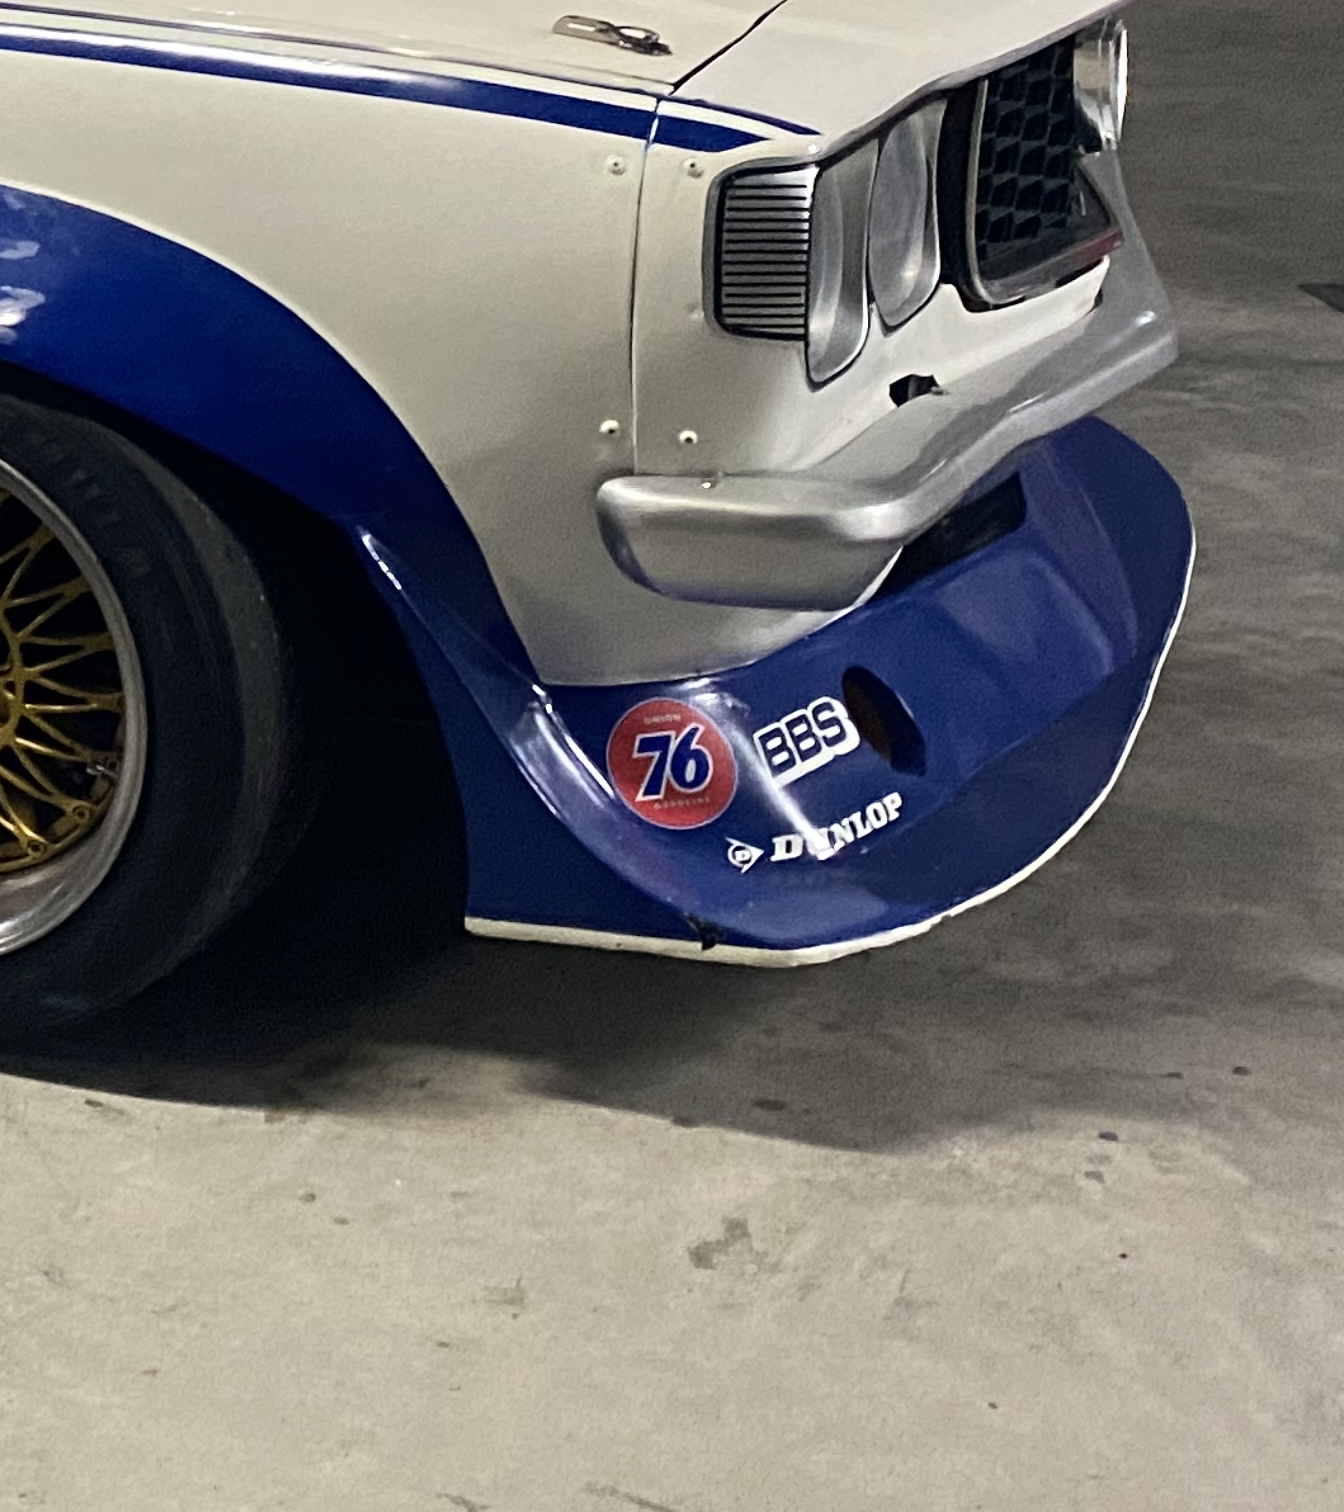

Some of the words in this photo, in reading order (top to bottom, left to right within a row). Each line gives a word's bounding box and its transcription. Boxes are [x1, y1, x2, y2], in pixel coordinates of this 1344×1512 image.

[632, 722, 713, 802] 76
[759, 699, 848, 776] BBS
[770, 792, 903, 862] DUNLOP
